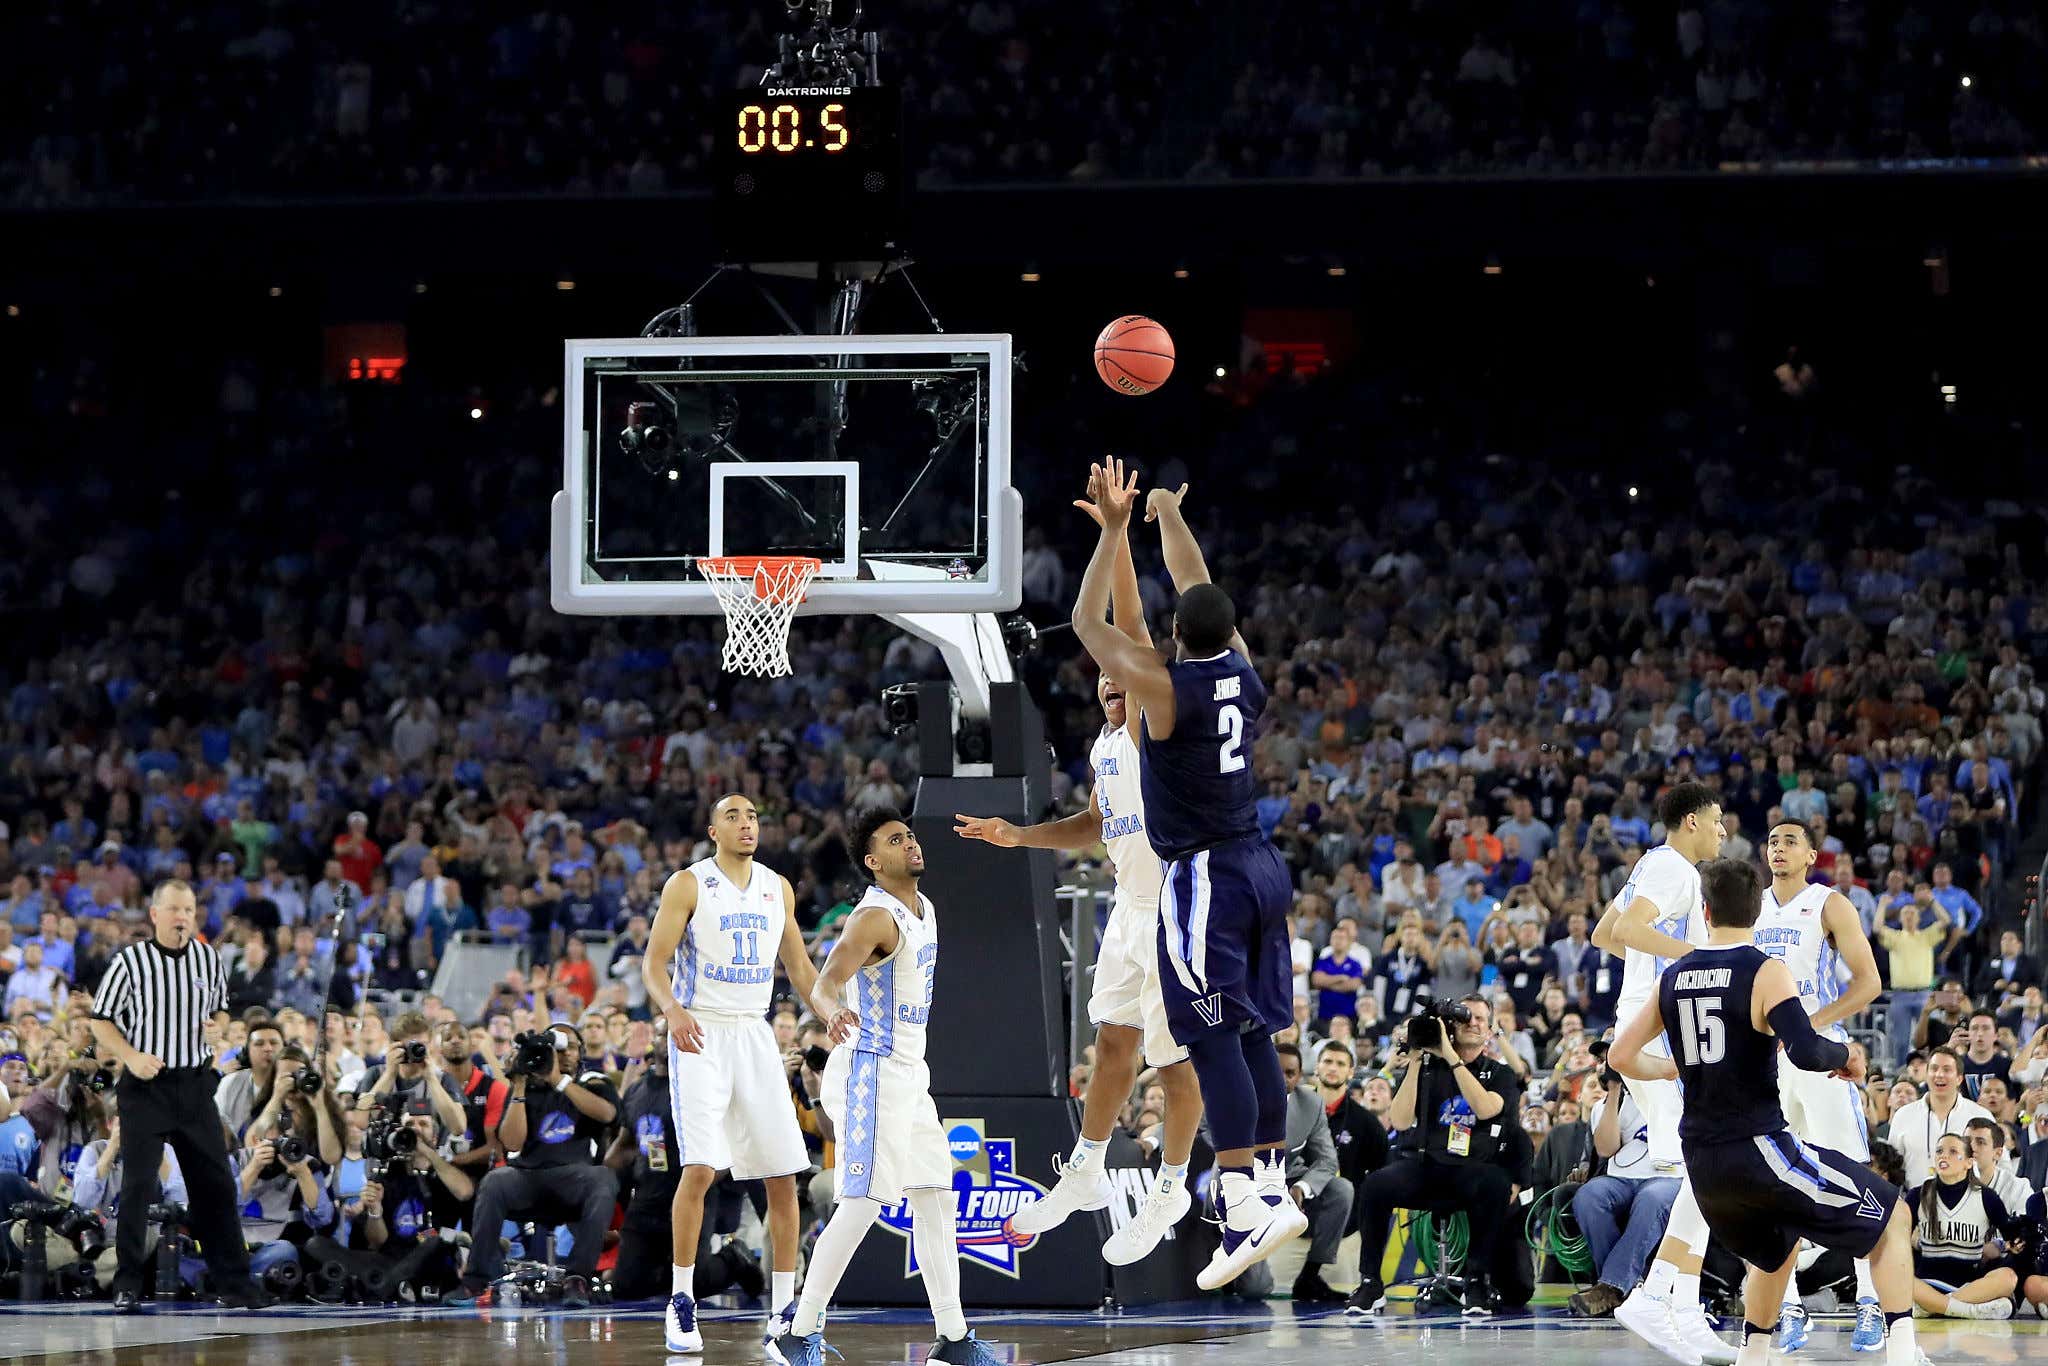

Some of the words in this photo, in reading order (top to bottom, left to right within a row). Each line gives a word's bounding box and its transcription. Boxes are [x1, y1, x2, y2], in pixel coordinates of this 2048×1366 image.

[767, 87, 851, 96] DAKTRONICS
[738, 104, 848, 152] 00.5
[1217, 704, 1246, 774] 2
[1103, 813, 1143, 840] LINA
[719, 913, 769, 931] NORTH
[731, 931, 759, 965] 11
[1753, 928, 1802, 946] NORTH
[703, 963, 772, 984] CAROLIN
[1674, 968, 1733, 990] ARCIDIACONO
[1677, 996, 1726, 1066] 15
[1479, 1070, 1491, 1079] 21
[949, 1141, 980, 1152] NCAA
[965, 1190, 1037, 1218] FOUR
[972, 1220, 1002, 1230] 2016
[1921, 1221, 1979, 1243] VILANOVA
